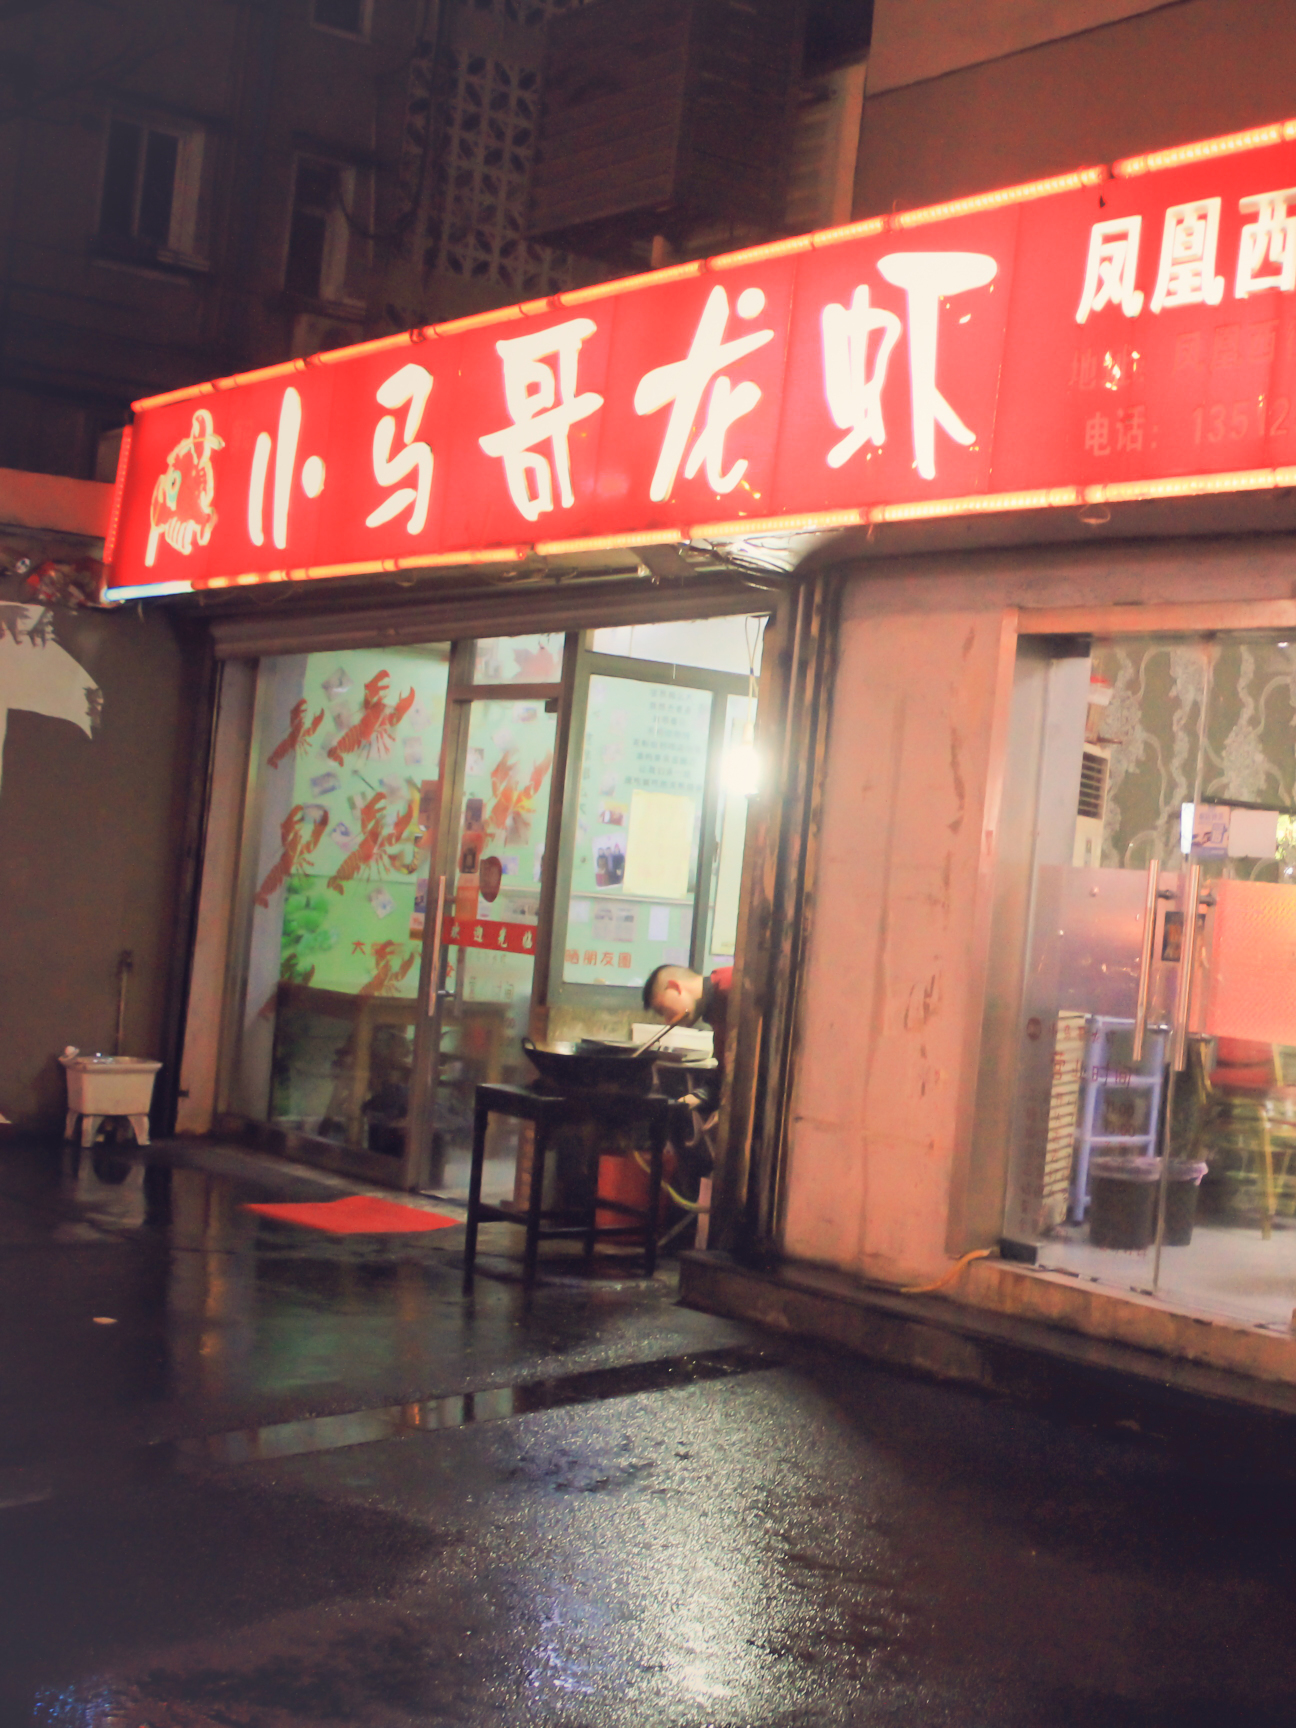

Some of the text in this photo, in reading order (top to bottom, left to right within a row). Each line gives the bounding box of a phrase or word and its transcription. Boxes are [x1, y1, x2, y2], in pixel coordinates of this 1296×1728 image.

[248, 251, 999, 550] 小马哥龙虾
